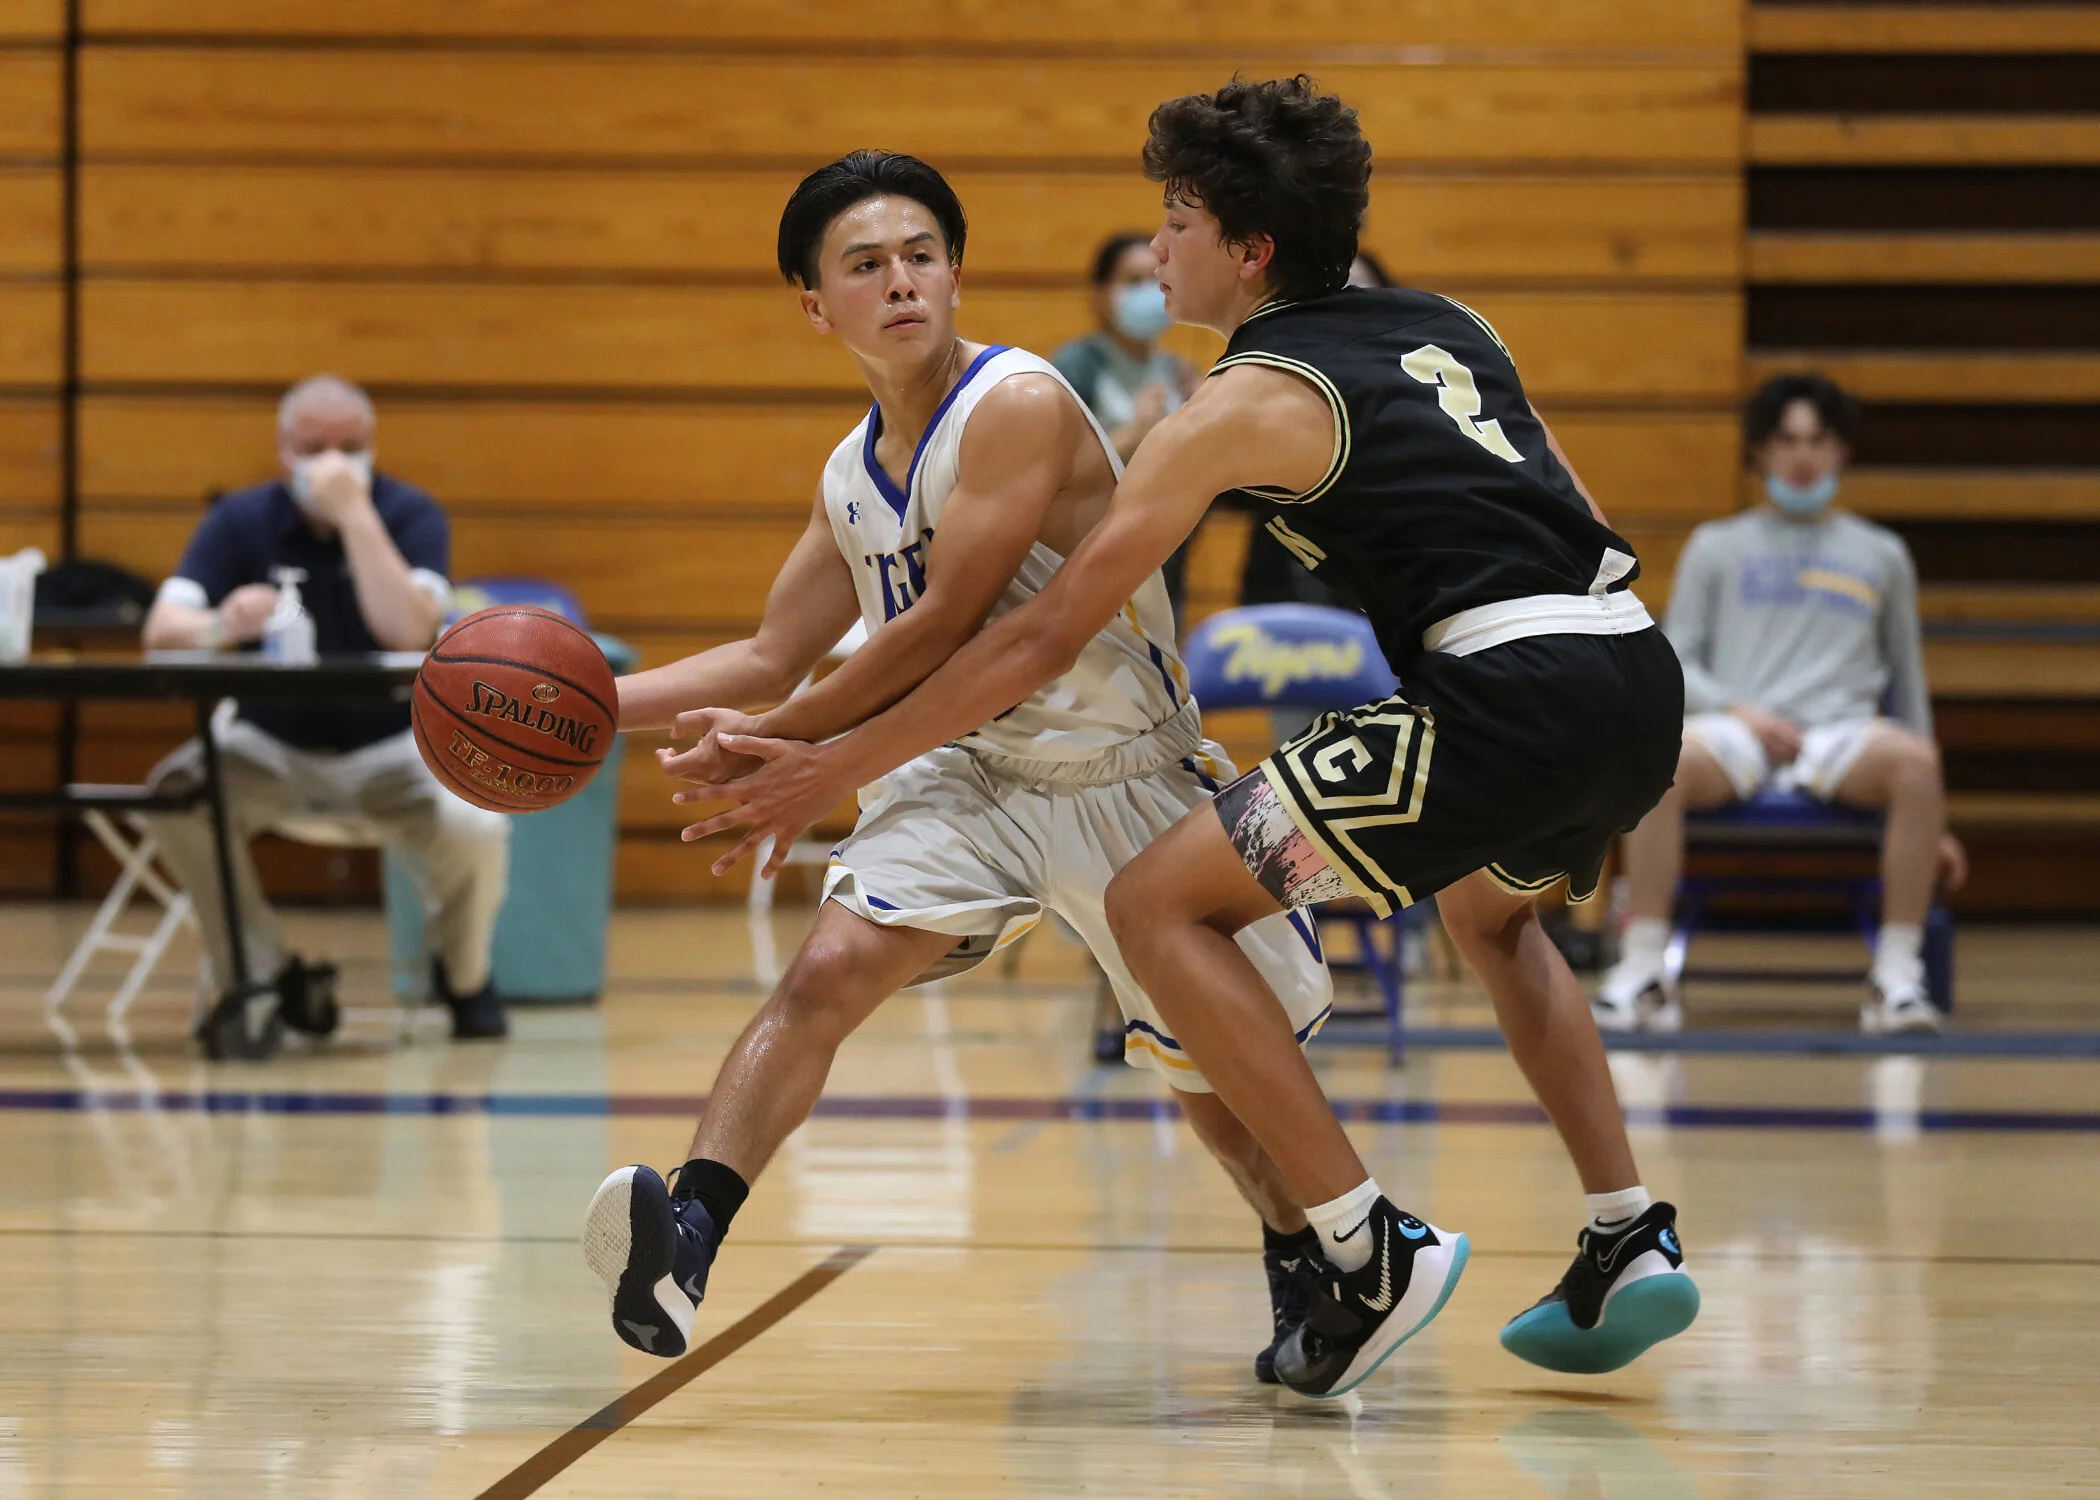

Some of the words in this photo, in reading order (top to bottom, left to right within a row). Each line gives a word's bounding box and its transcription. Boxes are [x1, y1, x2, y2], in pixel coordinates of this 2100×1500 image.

[1400, 344, 1526, 463] 2
[1208, 623, 1362, 697] Tigers
[465, 680, 599, 755] SPALDING
[449, 728, 575, 794] TF-1000
